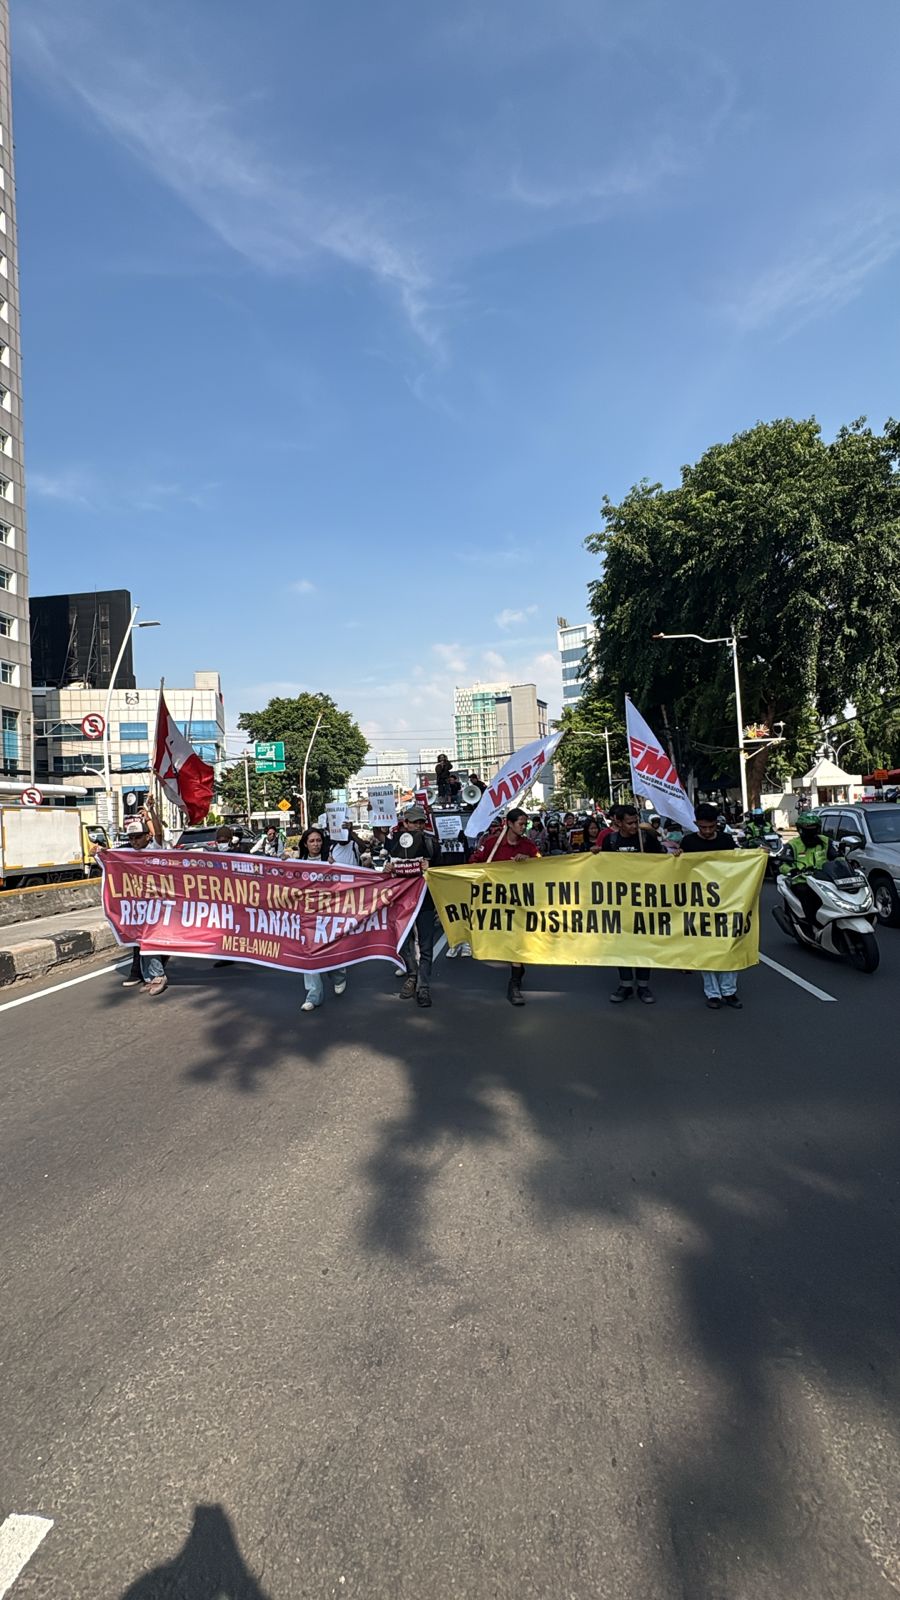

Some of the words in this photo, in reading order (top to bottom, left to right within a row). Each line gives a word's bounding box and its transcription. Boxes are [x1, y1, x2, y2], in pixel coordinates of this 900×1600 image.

[108, 872, 176, 898] LAWAN
[183, 874, 260, 907] PERANG
[470, 882, 534, 906] PERAN
[545, 882, 580, 906] TNI
[592, 881, 720, 908] DIPERLUAS
[120, 900, 176, 926] REBUT
[181, 901, 240, 931] UPAH,
[244, 907, 306, 945] TANAH,
[526, 910, 621, 934] DISIRAM
[634, 912, 672, 936] AIR
[684, 910, 752, 938] KERAS
